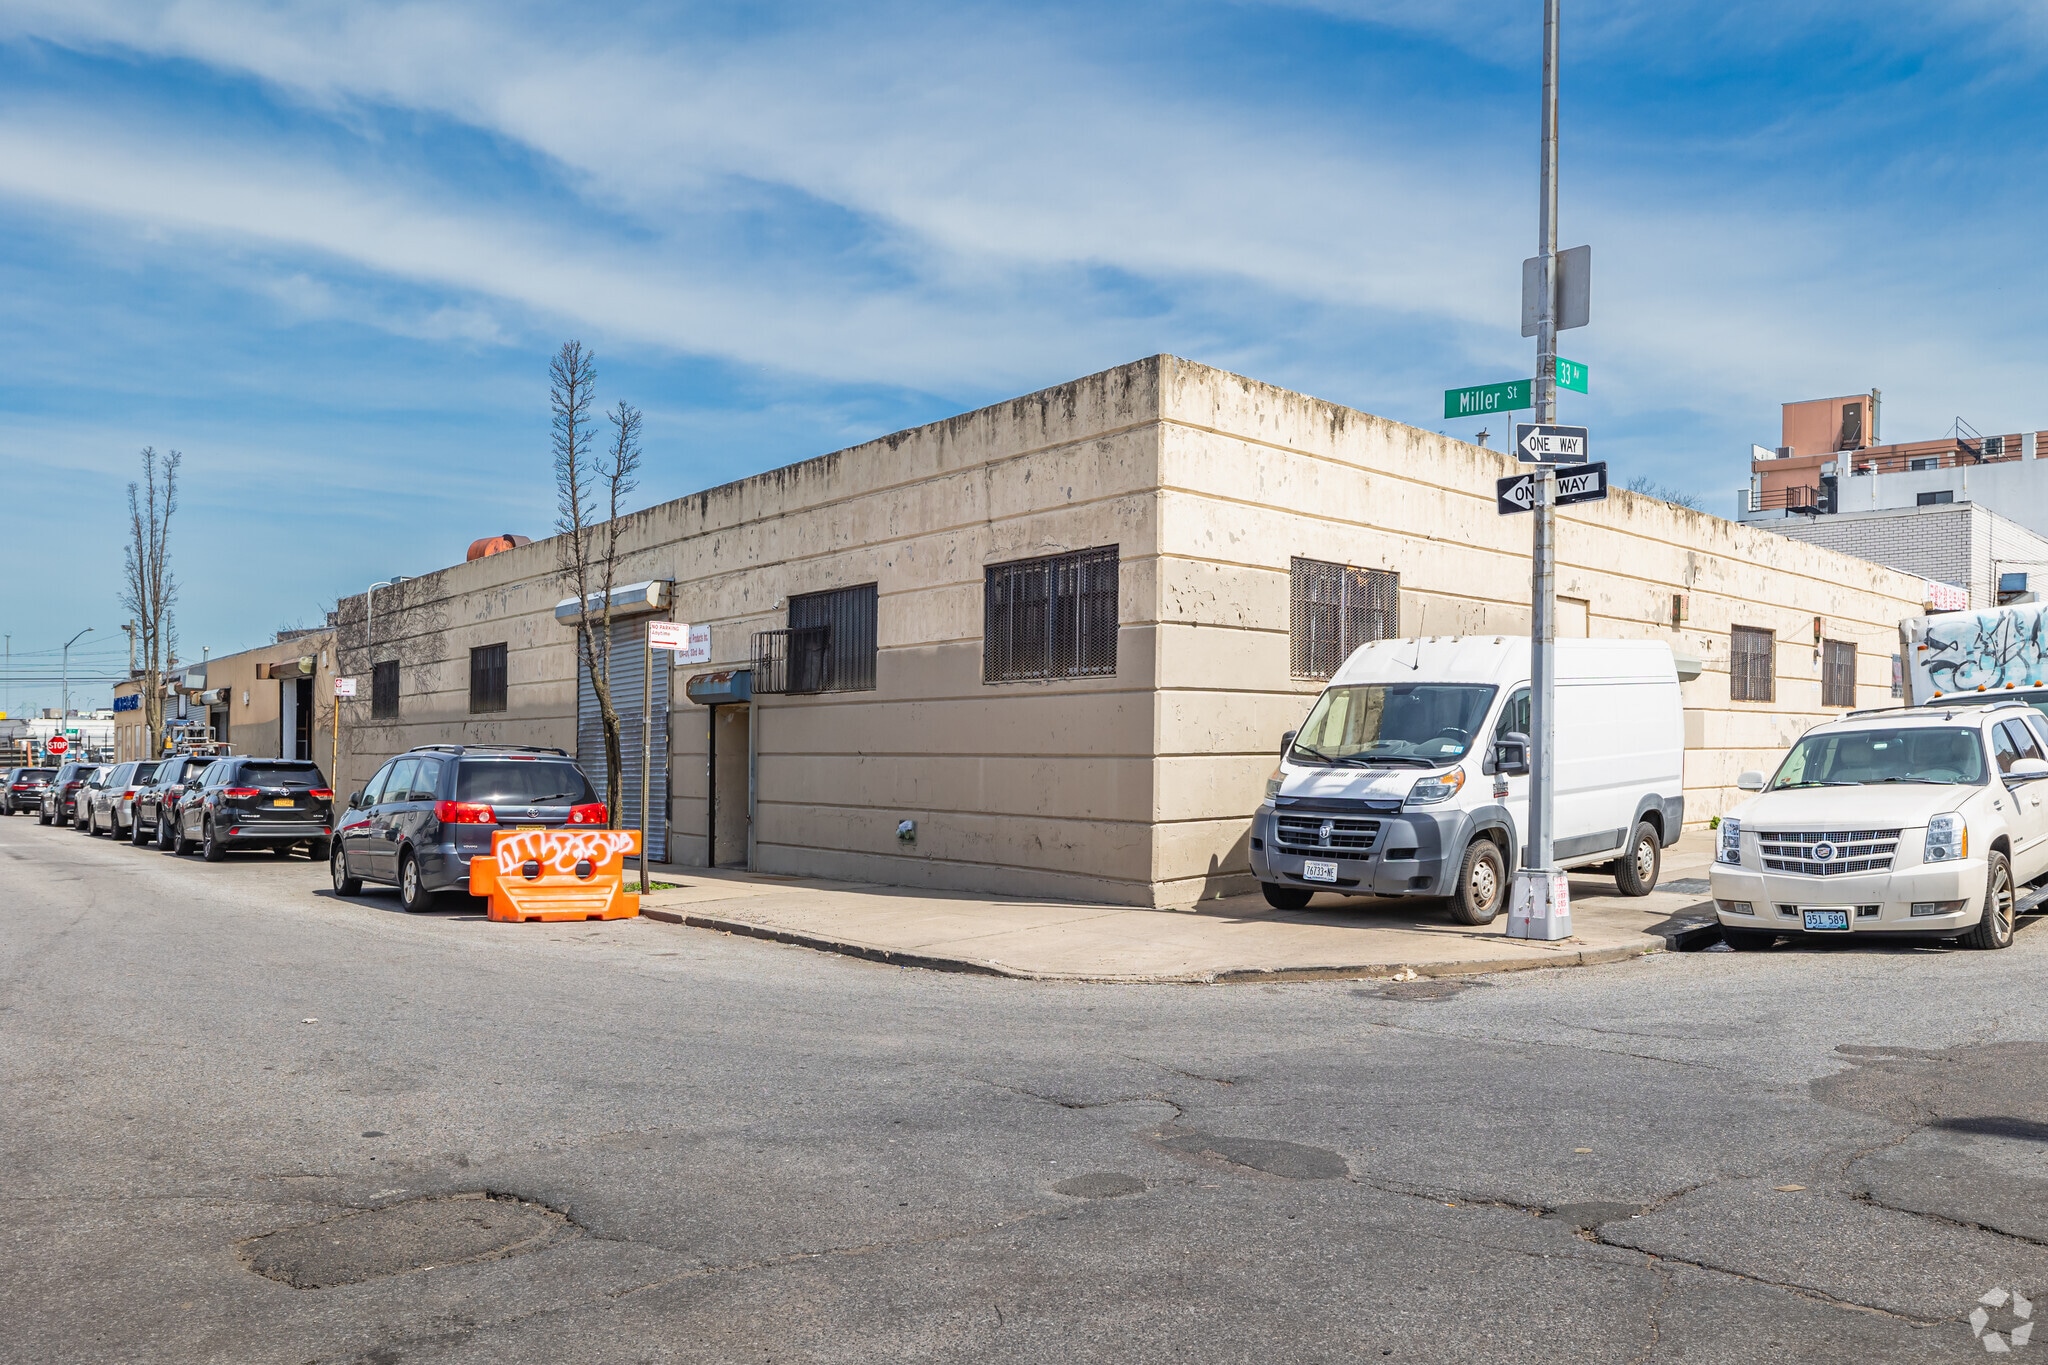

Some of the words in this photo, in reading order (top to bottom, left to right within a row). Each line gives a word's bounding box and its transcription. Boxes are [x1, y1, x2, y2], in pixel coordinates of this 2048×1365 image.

[1560, 362, 1571, 385] 33
[1573, 366, 1580, 379] Av
[1460, 390, 1501, 413] Miller
[1507, 385, 1518, 400] St
[1529, 436, 1550, 452] ONE
[1560, 437, 1578, 453] WAY
[1515, 485, 1535, 501] ON
[1558, 475, 1590, 495] WAY
[659, 624, 680, 632] PARKING
[48, 741, 67, 749] STOP
[1806, 914, 1823, 925] 351
[1828, 914, 1844, 925] 589
